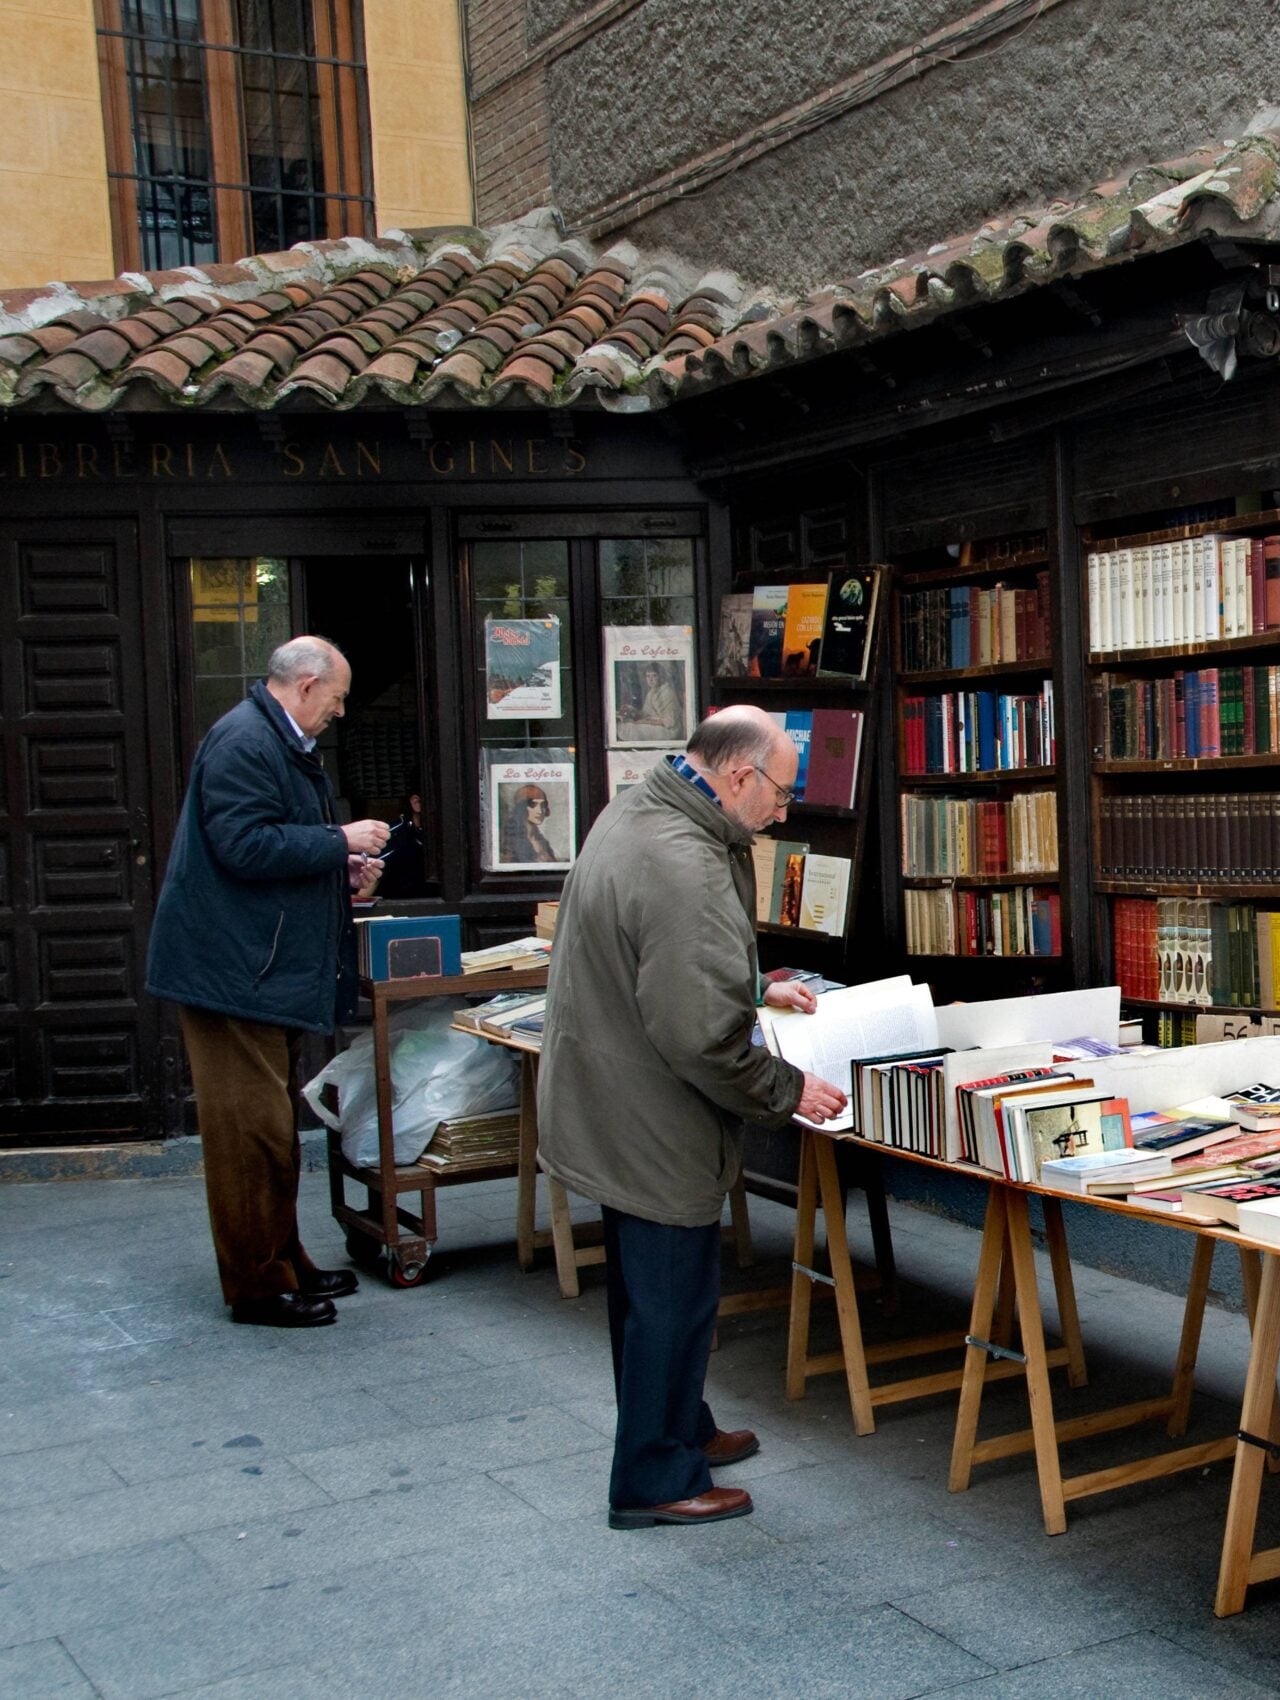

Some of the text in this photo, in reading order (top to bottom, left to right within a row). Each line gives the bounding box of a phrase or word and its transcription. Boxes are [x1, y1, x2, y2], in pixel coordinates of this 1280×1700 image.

[0, 438, 587, 478] IBRERIA SAN GINES
